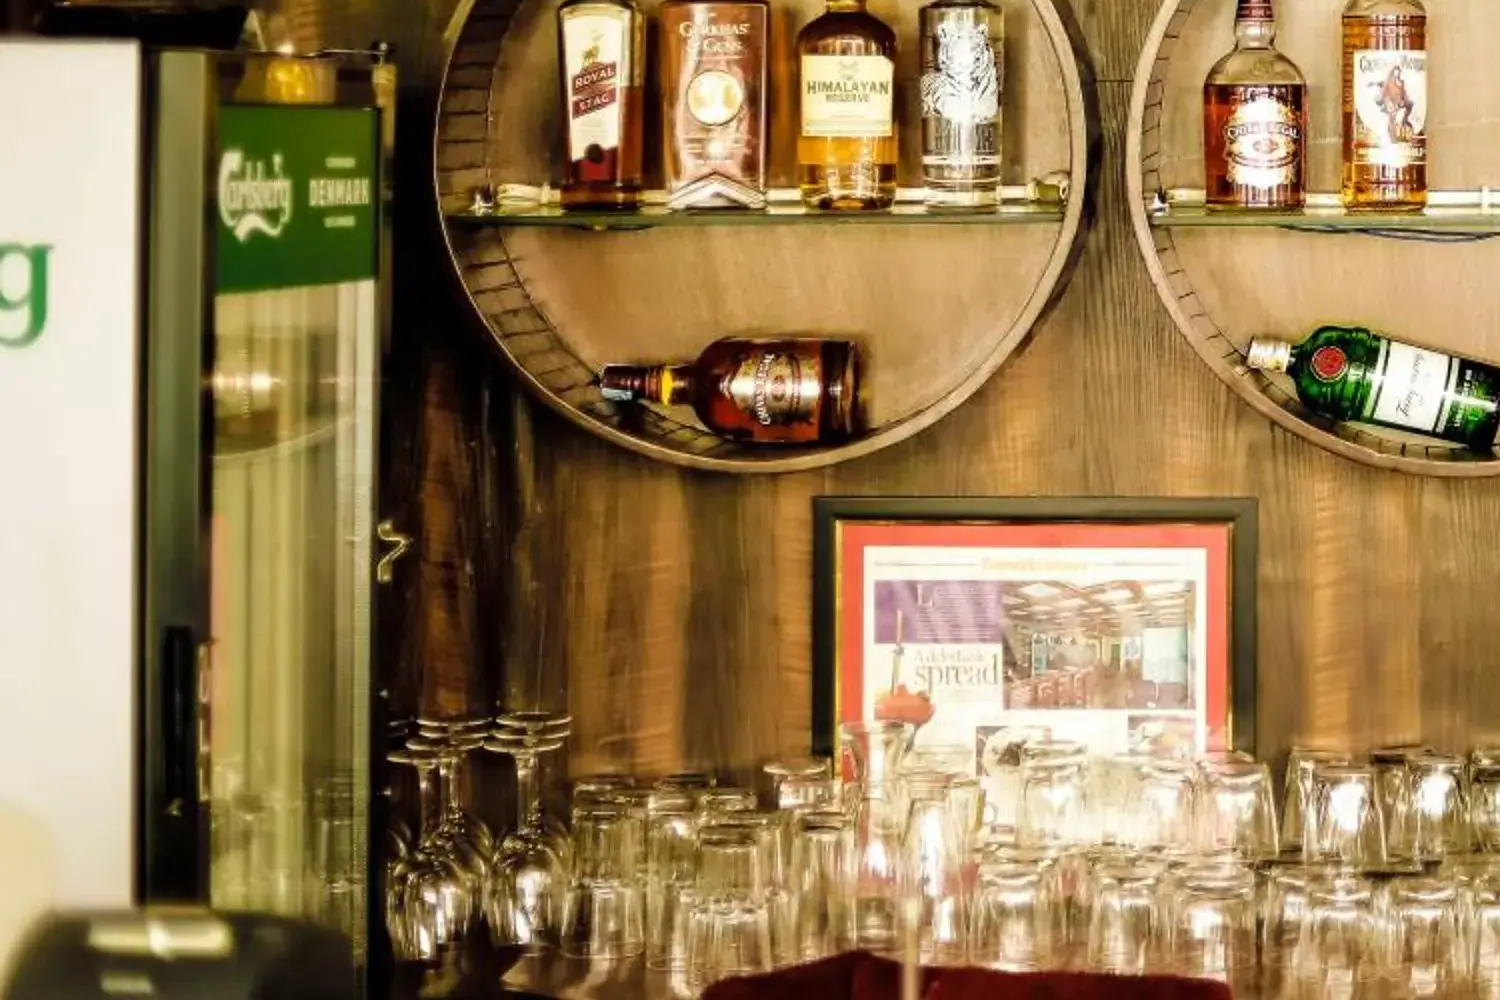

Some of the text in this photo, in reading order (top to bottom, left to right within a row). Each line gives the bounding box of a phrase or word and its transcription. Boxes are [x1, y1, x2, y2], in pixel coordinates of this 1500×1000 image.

[679, 21, 750, 37] GRKHAS
[575, 65, 614, 89] ROYAL
[806, 81, 889, 95] HIMALAYAN
[579, 94, 610, 111] STAG
[308, 178, 370, 207] DENMARK
[914, 652, 998, 695] spread
